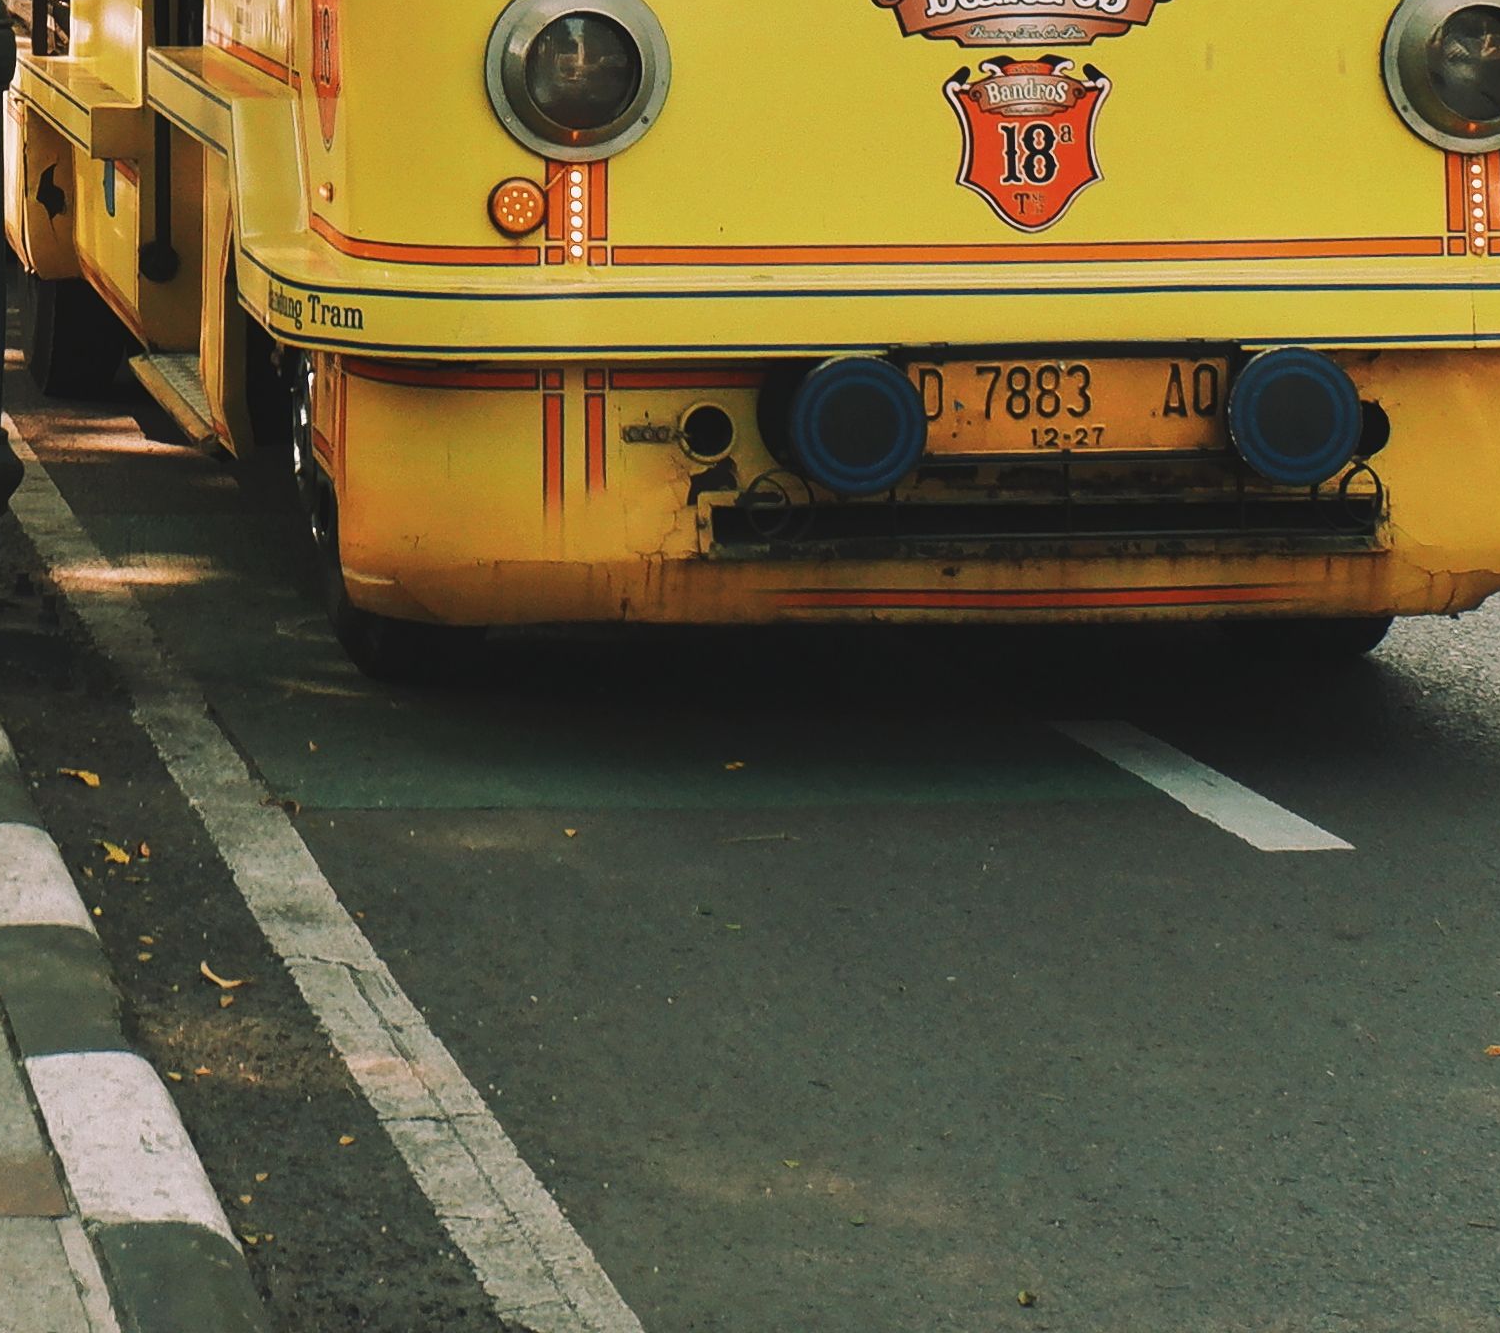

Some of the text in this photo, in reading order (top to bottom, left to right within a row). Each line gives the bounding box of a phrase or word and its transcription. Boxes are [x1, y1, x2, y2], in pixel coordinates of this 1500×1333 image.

[985, 78, 1069, 105] Bandros
[307, 294, 364, 330] Tram
[918, 367, 944, 422] D
[976, 364, 1092, 420] 7883
